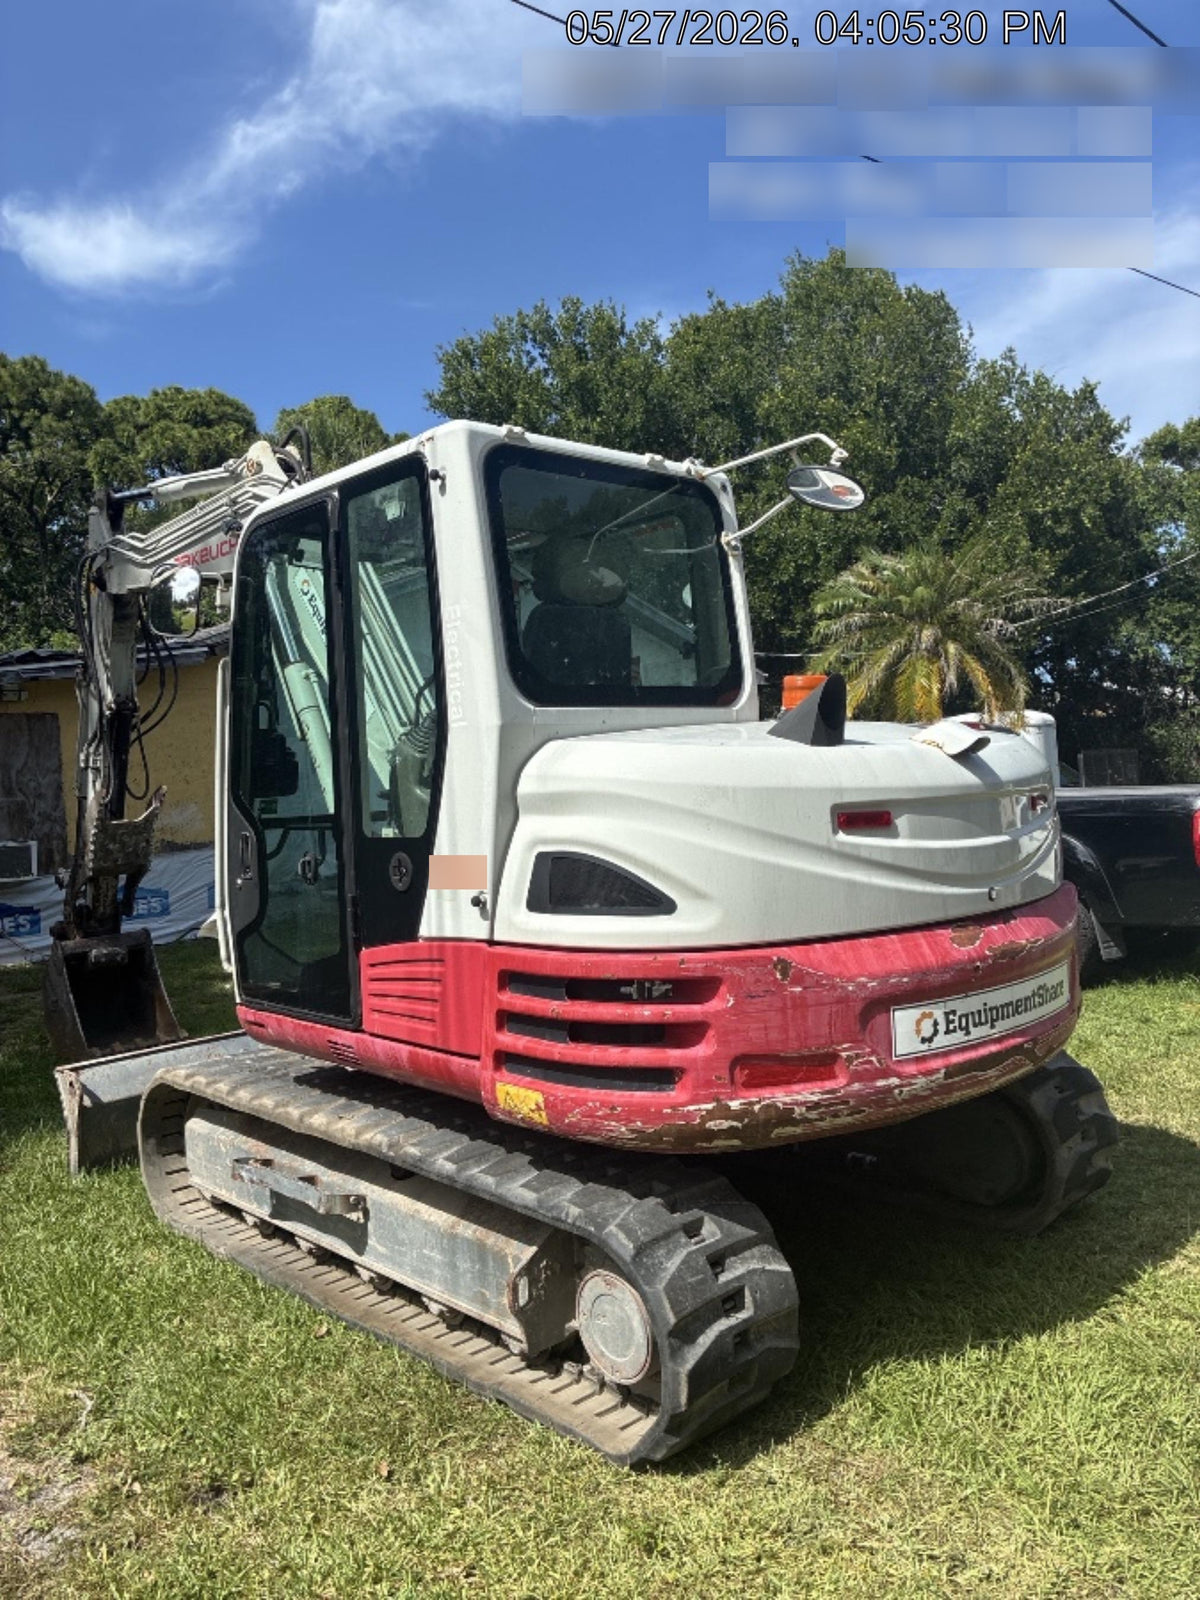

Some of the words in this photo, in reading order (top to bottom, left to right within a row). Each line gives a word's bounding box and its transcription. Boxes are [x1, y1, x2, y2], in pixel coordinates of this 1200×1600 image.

[446, 604, 467, 727] Electrical
[0, 913, 31, 933] E'S
[943, 979, 1065, 1037] EquipmentShare
